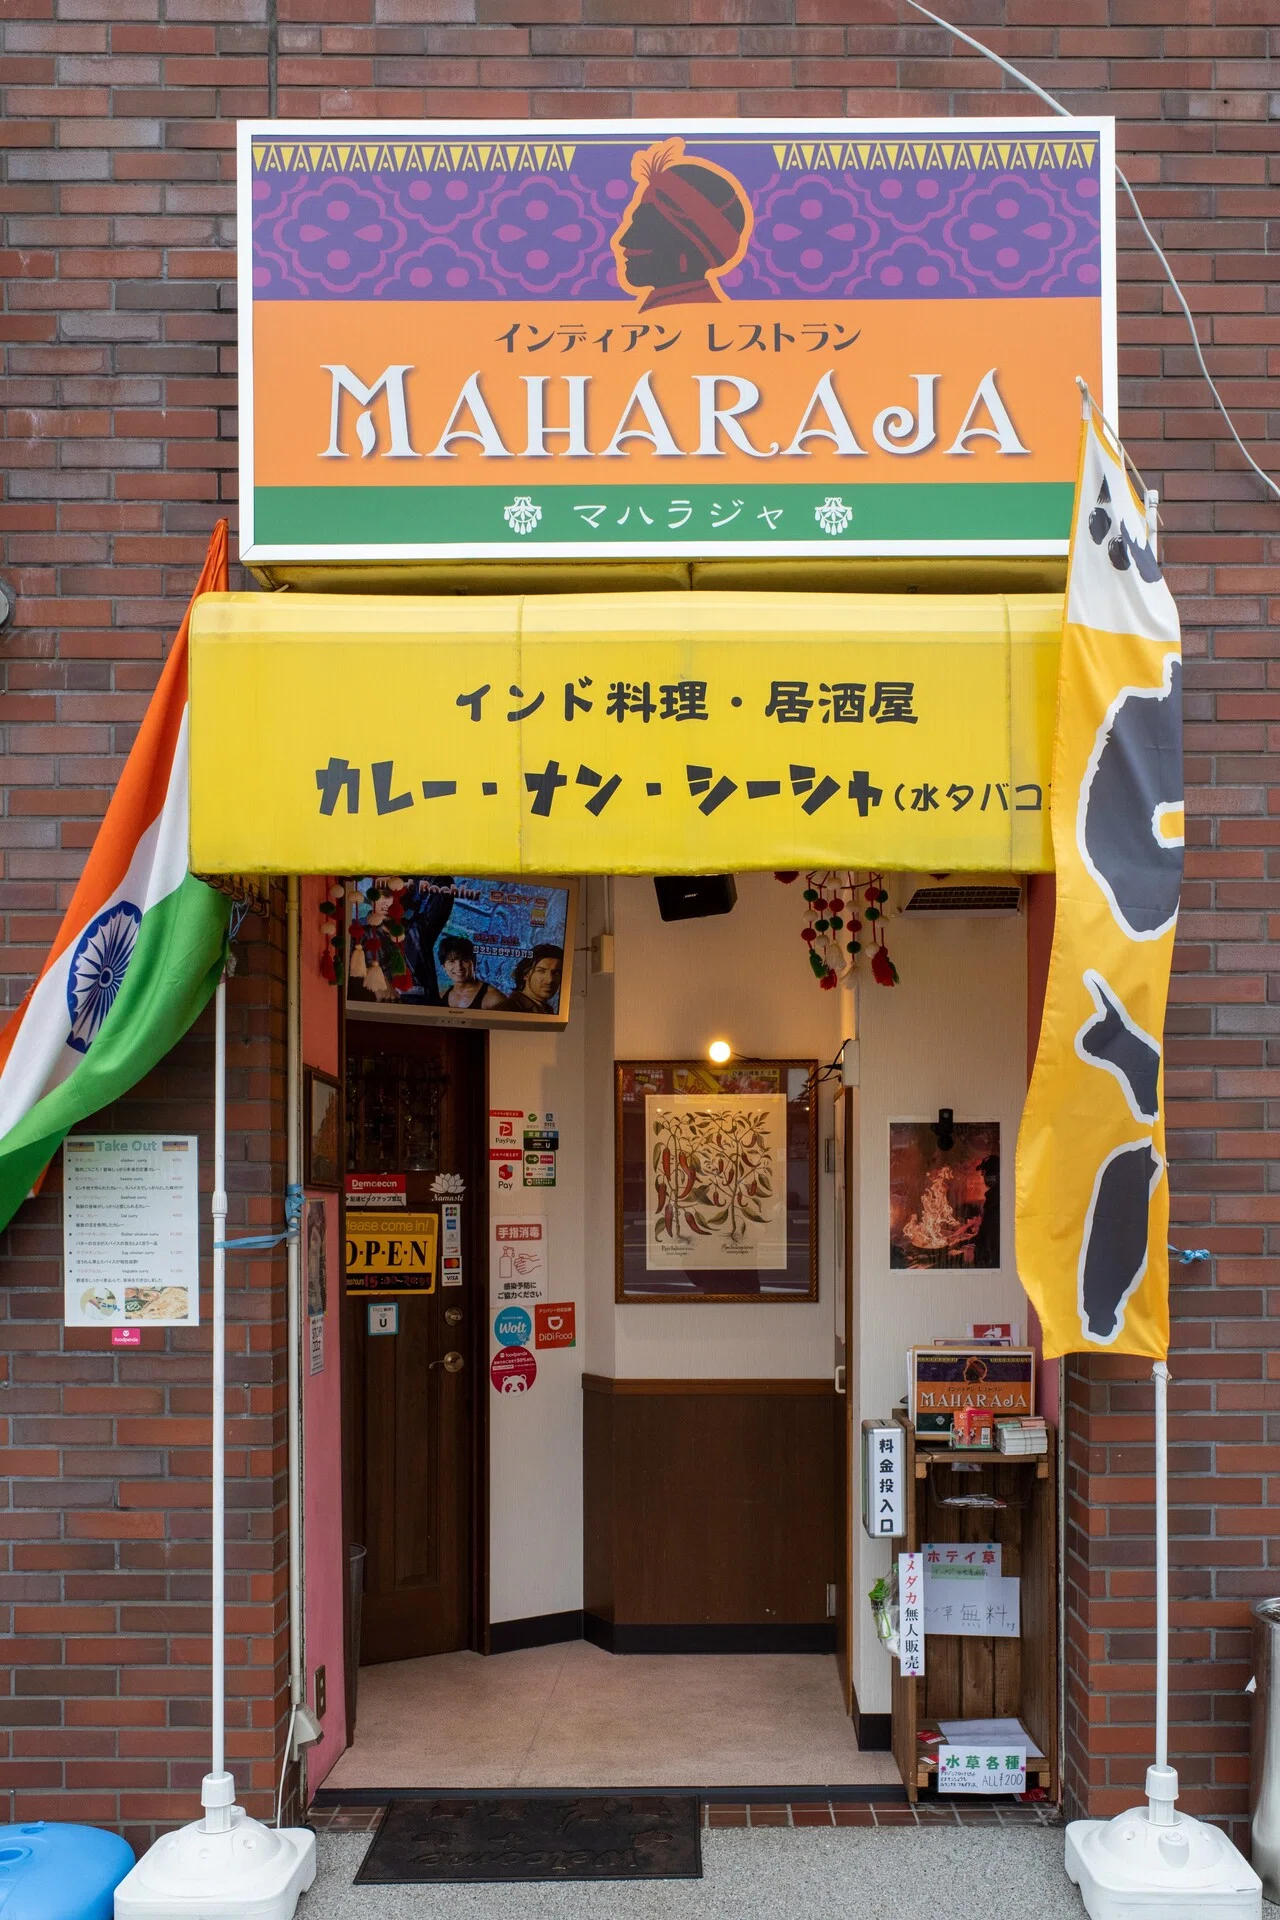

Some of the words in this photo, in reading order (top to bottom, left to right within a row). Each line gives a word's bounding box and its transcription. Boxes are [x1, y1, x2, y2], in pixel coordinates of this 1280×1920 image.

[495, 323, 682, 354] インディアン
[707, 323, 862, 353] レストラン
[317, 364, 1031, 459] MAHARAJA
[573, 499, 784, 530] マハラジャ
[455, 675, 919, 725] インド料理・居酒屋
[96, 1140, 128, 1152] Take
[132, 1140, 158, 1152] Out
[495, 1137, 517, 1145] PayPay
[498, 1181, 513, 1190] Pay
[346, 1220, 379, 1232] lease
[380, 1222, 413, 1232] come
[498, 1226, 540, 1239] 手指消毒
[503, 1281, 537, 1290] 感染予防に
[497, 1291, 542, 1300] ご協力ください
[499, 1321, 527, 1334] Wolt
[920, 1392, 1028, 1408] MAHARAJA
[879, 1438, 895, 1533] 料金投入口
[928, 1550, 996, 1564] ホテイ草
[904, 1559, 920, 1669] メダカ無人販売
[945, 1754, 1020, 1770] 水草各種
